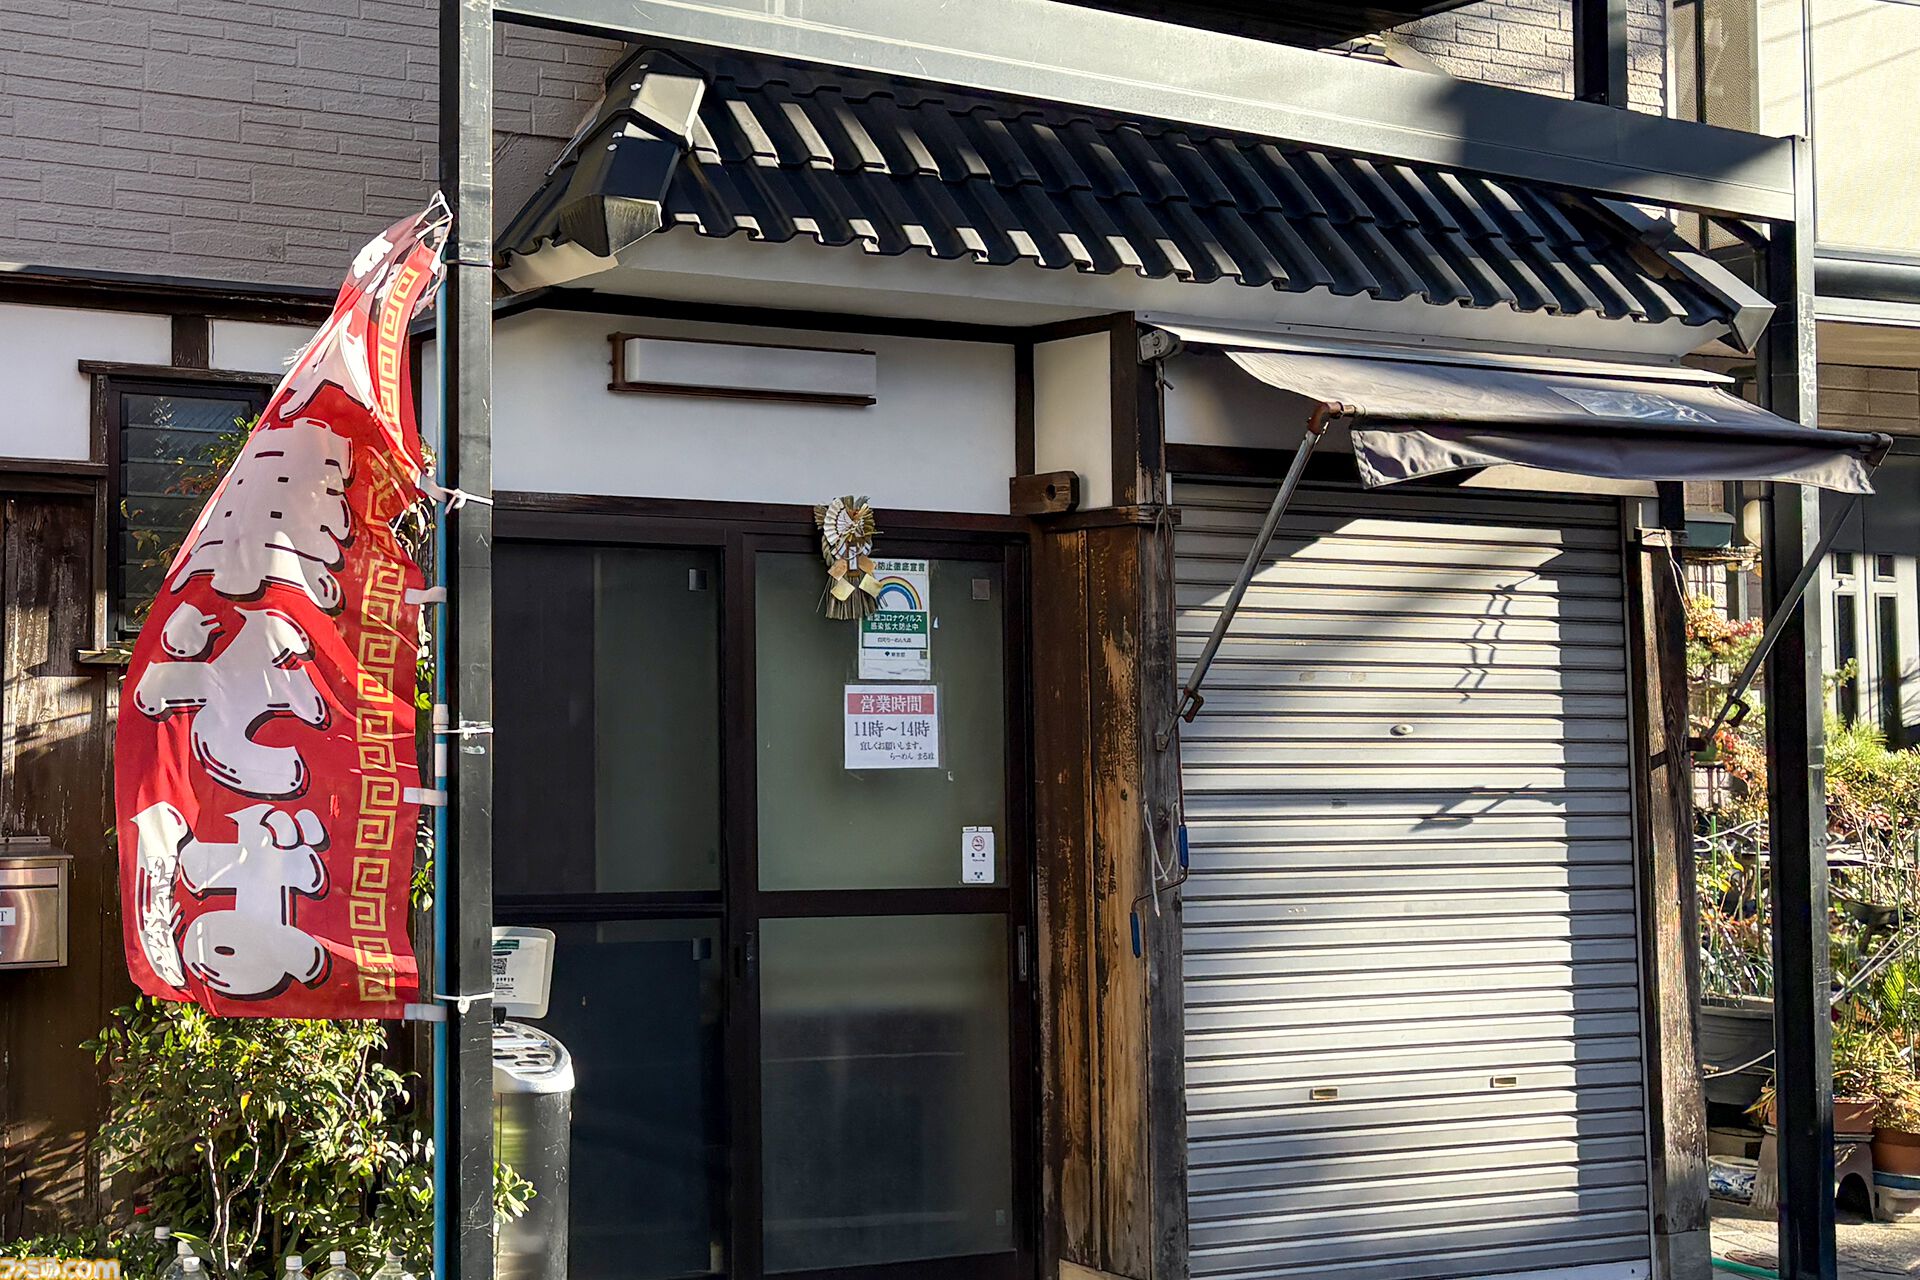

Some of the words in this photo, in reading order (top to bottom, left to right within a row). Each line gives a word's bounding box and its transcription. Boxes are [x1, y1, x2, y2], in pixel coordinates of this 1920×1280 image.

[875, 561, 925, 572] 防止徹底宣言
[860, 695, 922, 713] 営業時間
[854, 720, 930, 738] 11時～14時
[860, 741, 923, 751] 宜しくお願いします。
